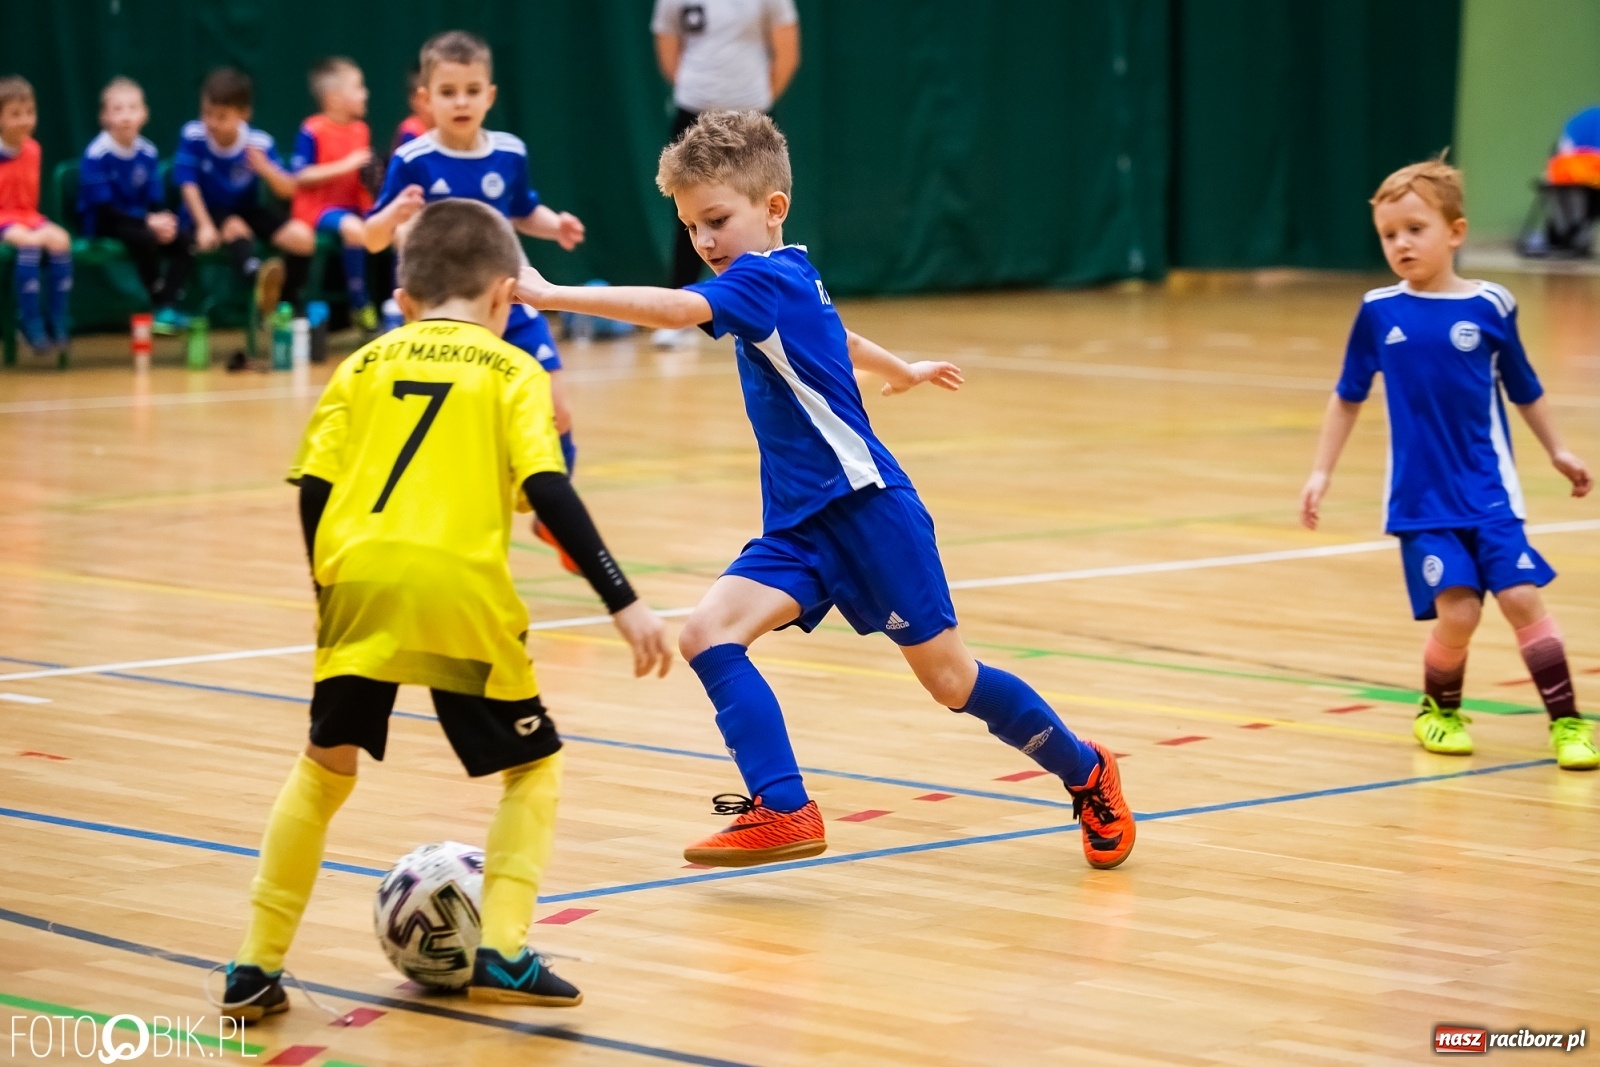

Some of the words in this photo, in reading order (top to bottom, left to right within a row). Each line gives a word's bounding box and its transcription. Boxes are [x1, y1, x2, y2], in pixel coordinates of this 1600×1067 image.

[406, 342, 519, 382] MARKOWICE
[370, 380, 454, 513] 7
[885, 621, 910, 630] adidas
